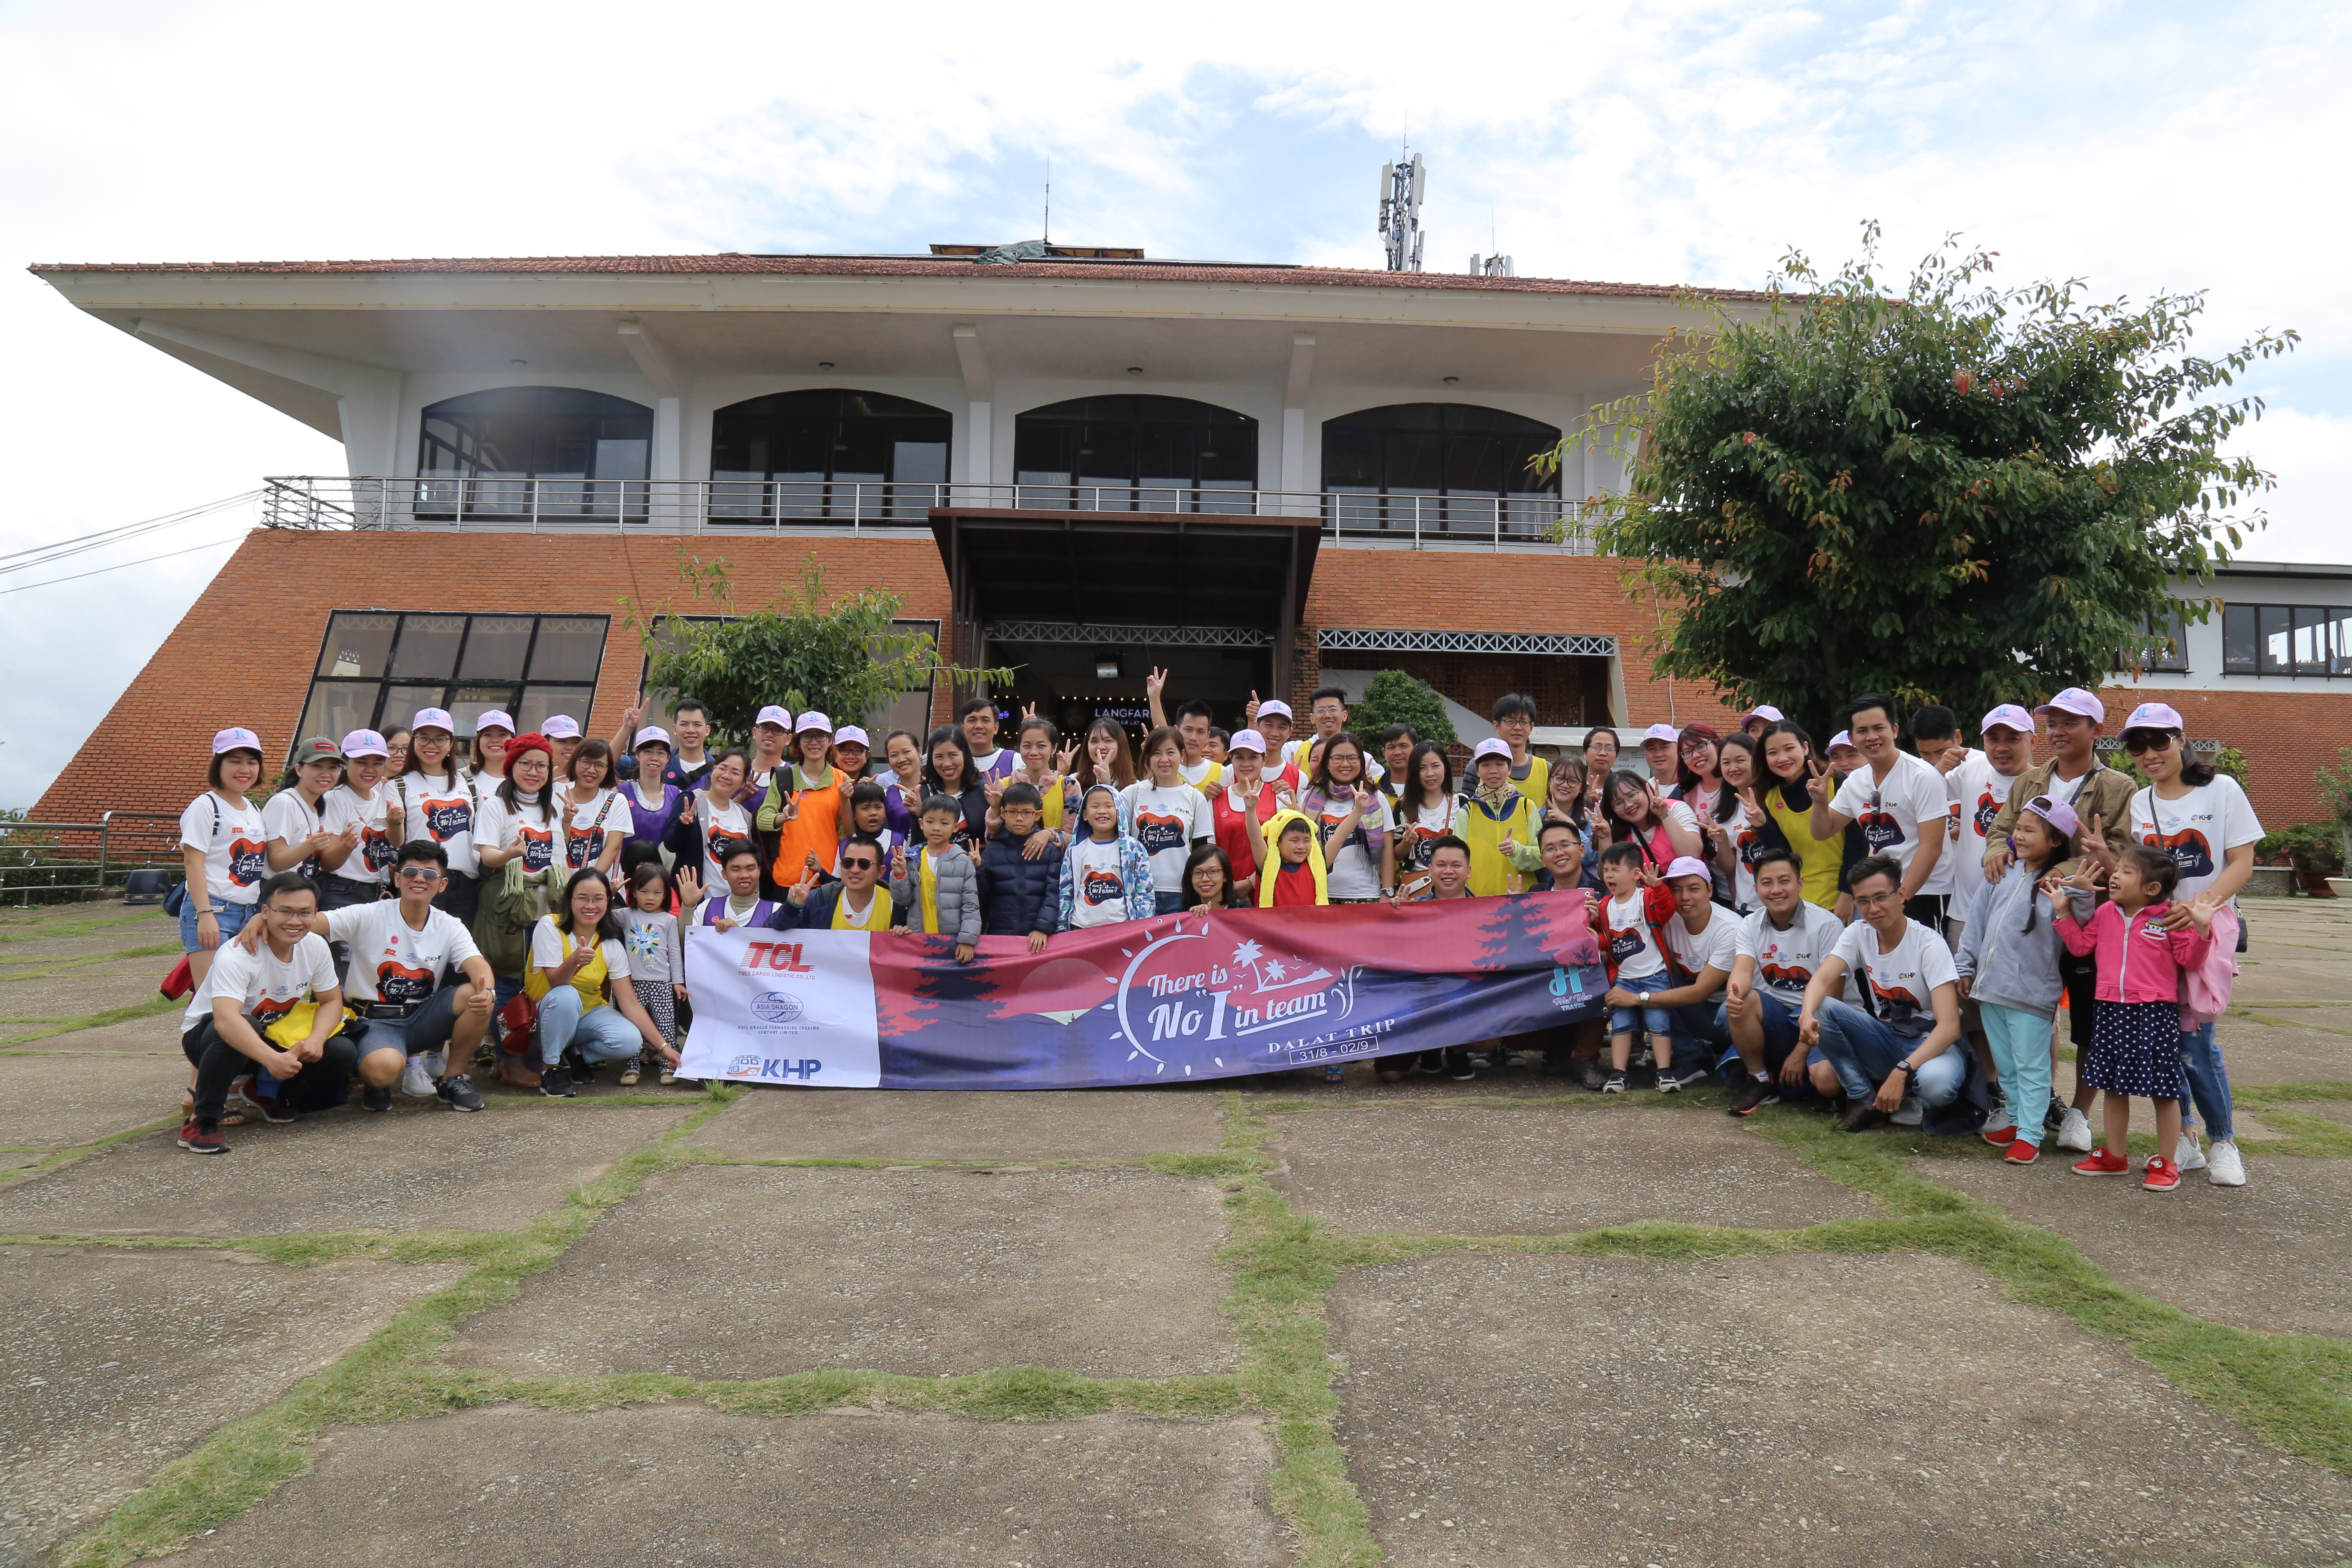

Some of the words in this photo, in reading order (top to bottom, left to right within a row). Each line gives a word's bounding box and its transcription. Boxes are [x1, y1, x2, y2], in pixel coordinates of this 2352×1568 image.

[1095, 708, 1152, 718] L'ANGFAR
[596, 812, 606, 824] LOVE
[602, 800, 612, 812] LOVE
[748, 941, 811, 972] TCL
[1147, 973, 1206, 998] There
[1211, 964, 1228, 985] is
[1147, 1001, 1204, 1041] No
[1234, 1005, 1259, 1029] in
[1266, 991, 1327, 1021] team
[1561, 1002, 1586, 1011] TRAVEL
[1267, 1032, 1338, 1054] DALAT
[1345, 1018, 1396, 1038] TRIP
[1299, 1048, 1328, 1061] 31/8
[1340, 1041, 1369, 1054] 02/9
[760, 1059, 822, 1080] KHP
